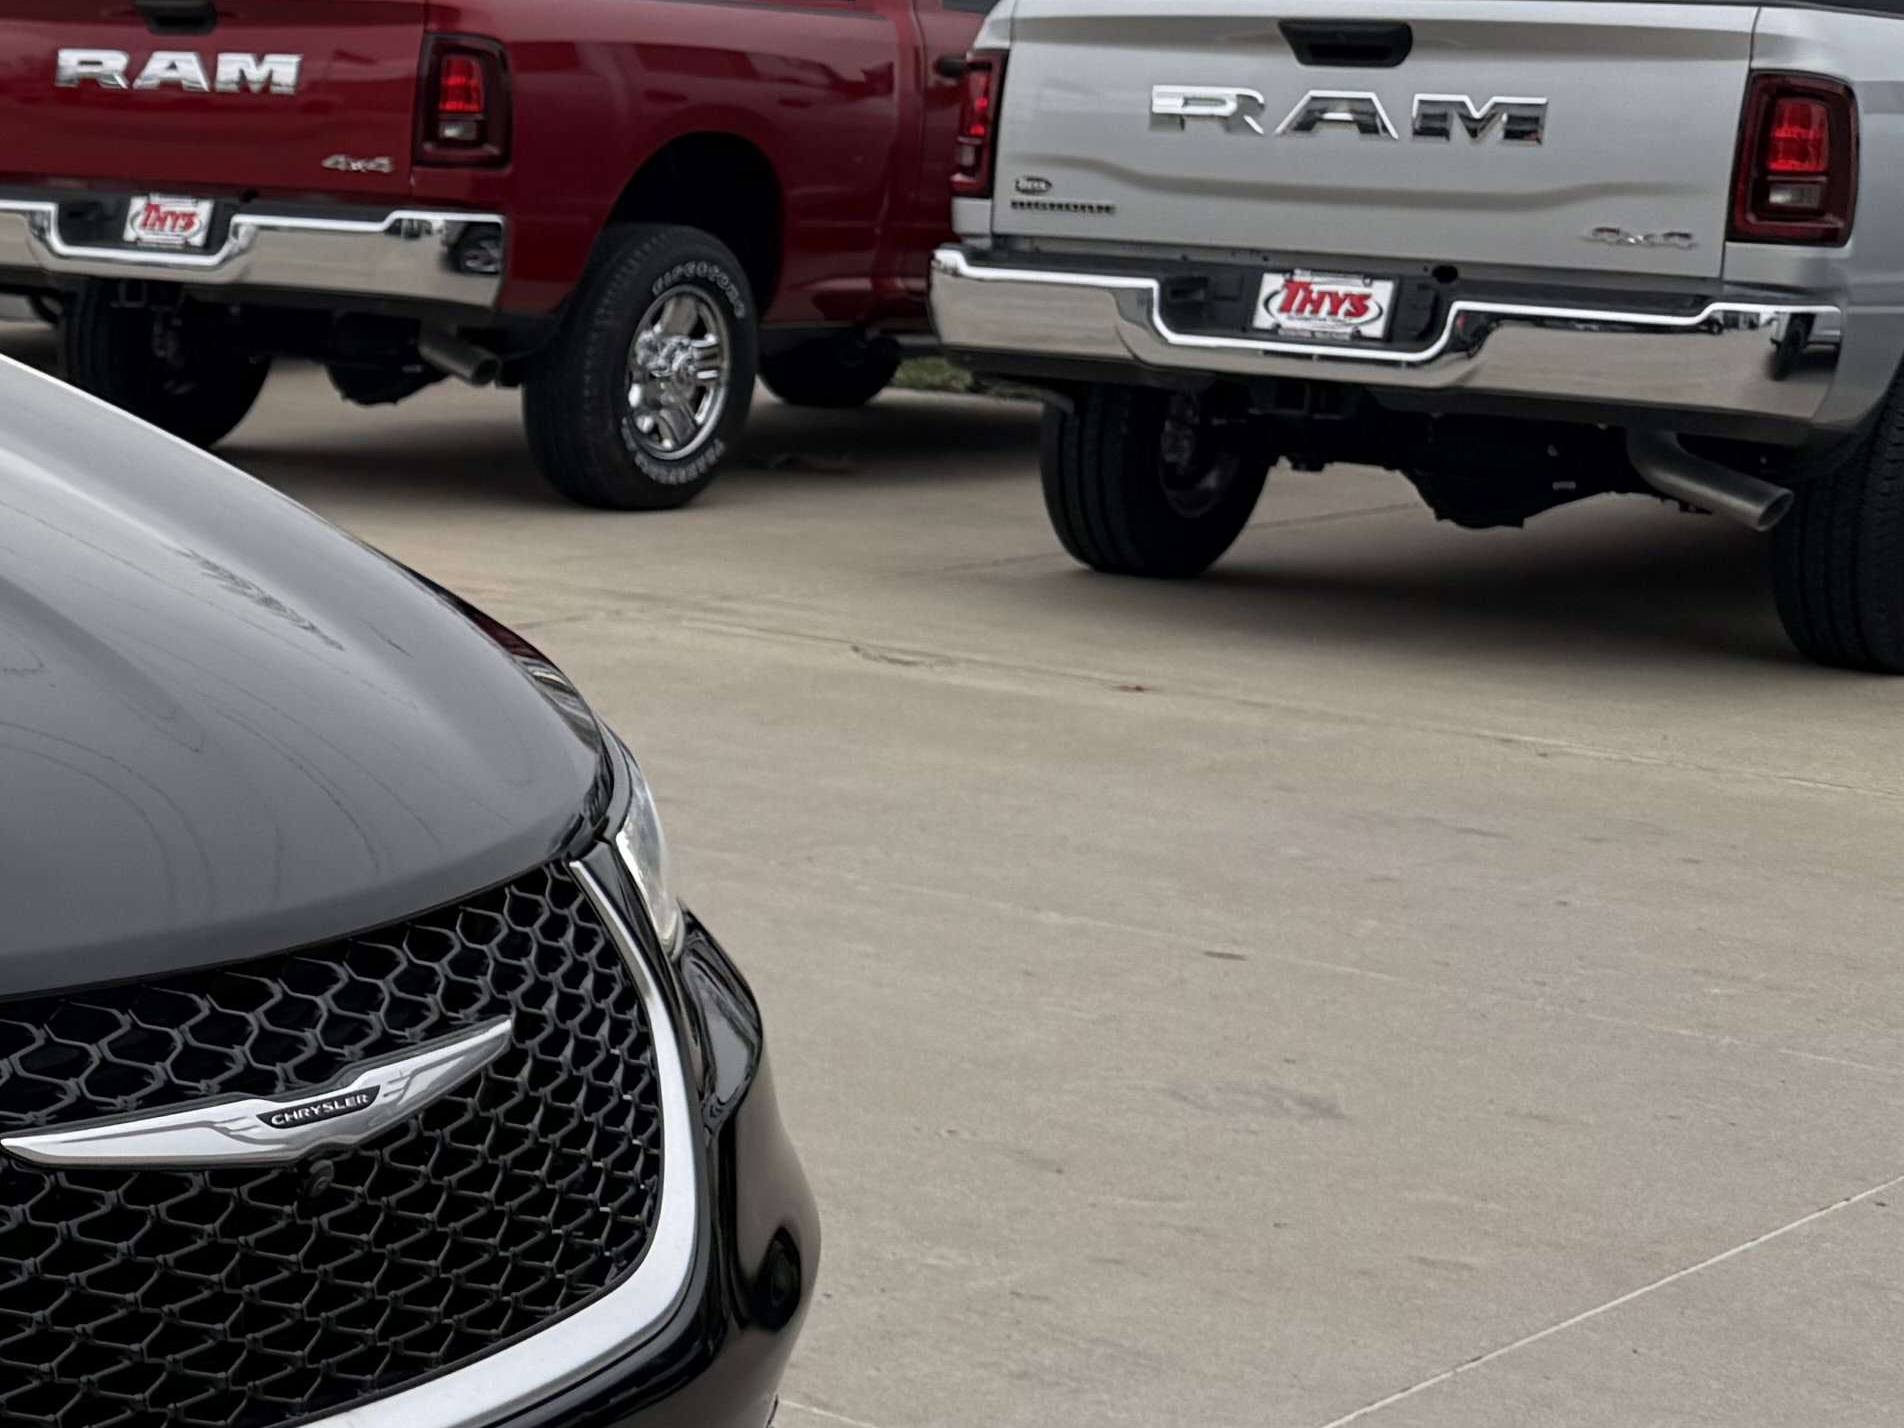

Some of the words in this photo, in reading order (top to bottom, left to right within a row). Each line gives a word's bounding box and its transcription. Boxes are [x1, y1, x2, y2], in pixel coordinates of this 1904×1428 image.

[54, 47, 304, 96] RAM
[1148, 84, 1550, 148] RAM
[1278, 280, 1373, 319] THYS
[270, 1093, 369, 1127] CHRYSLER
